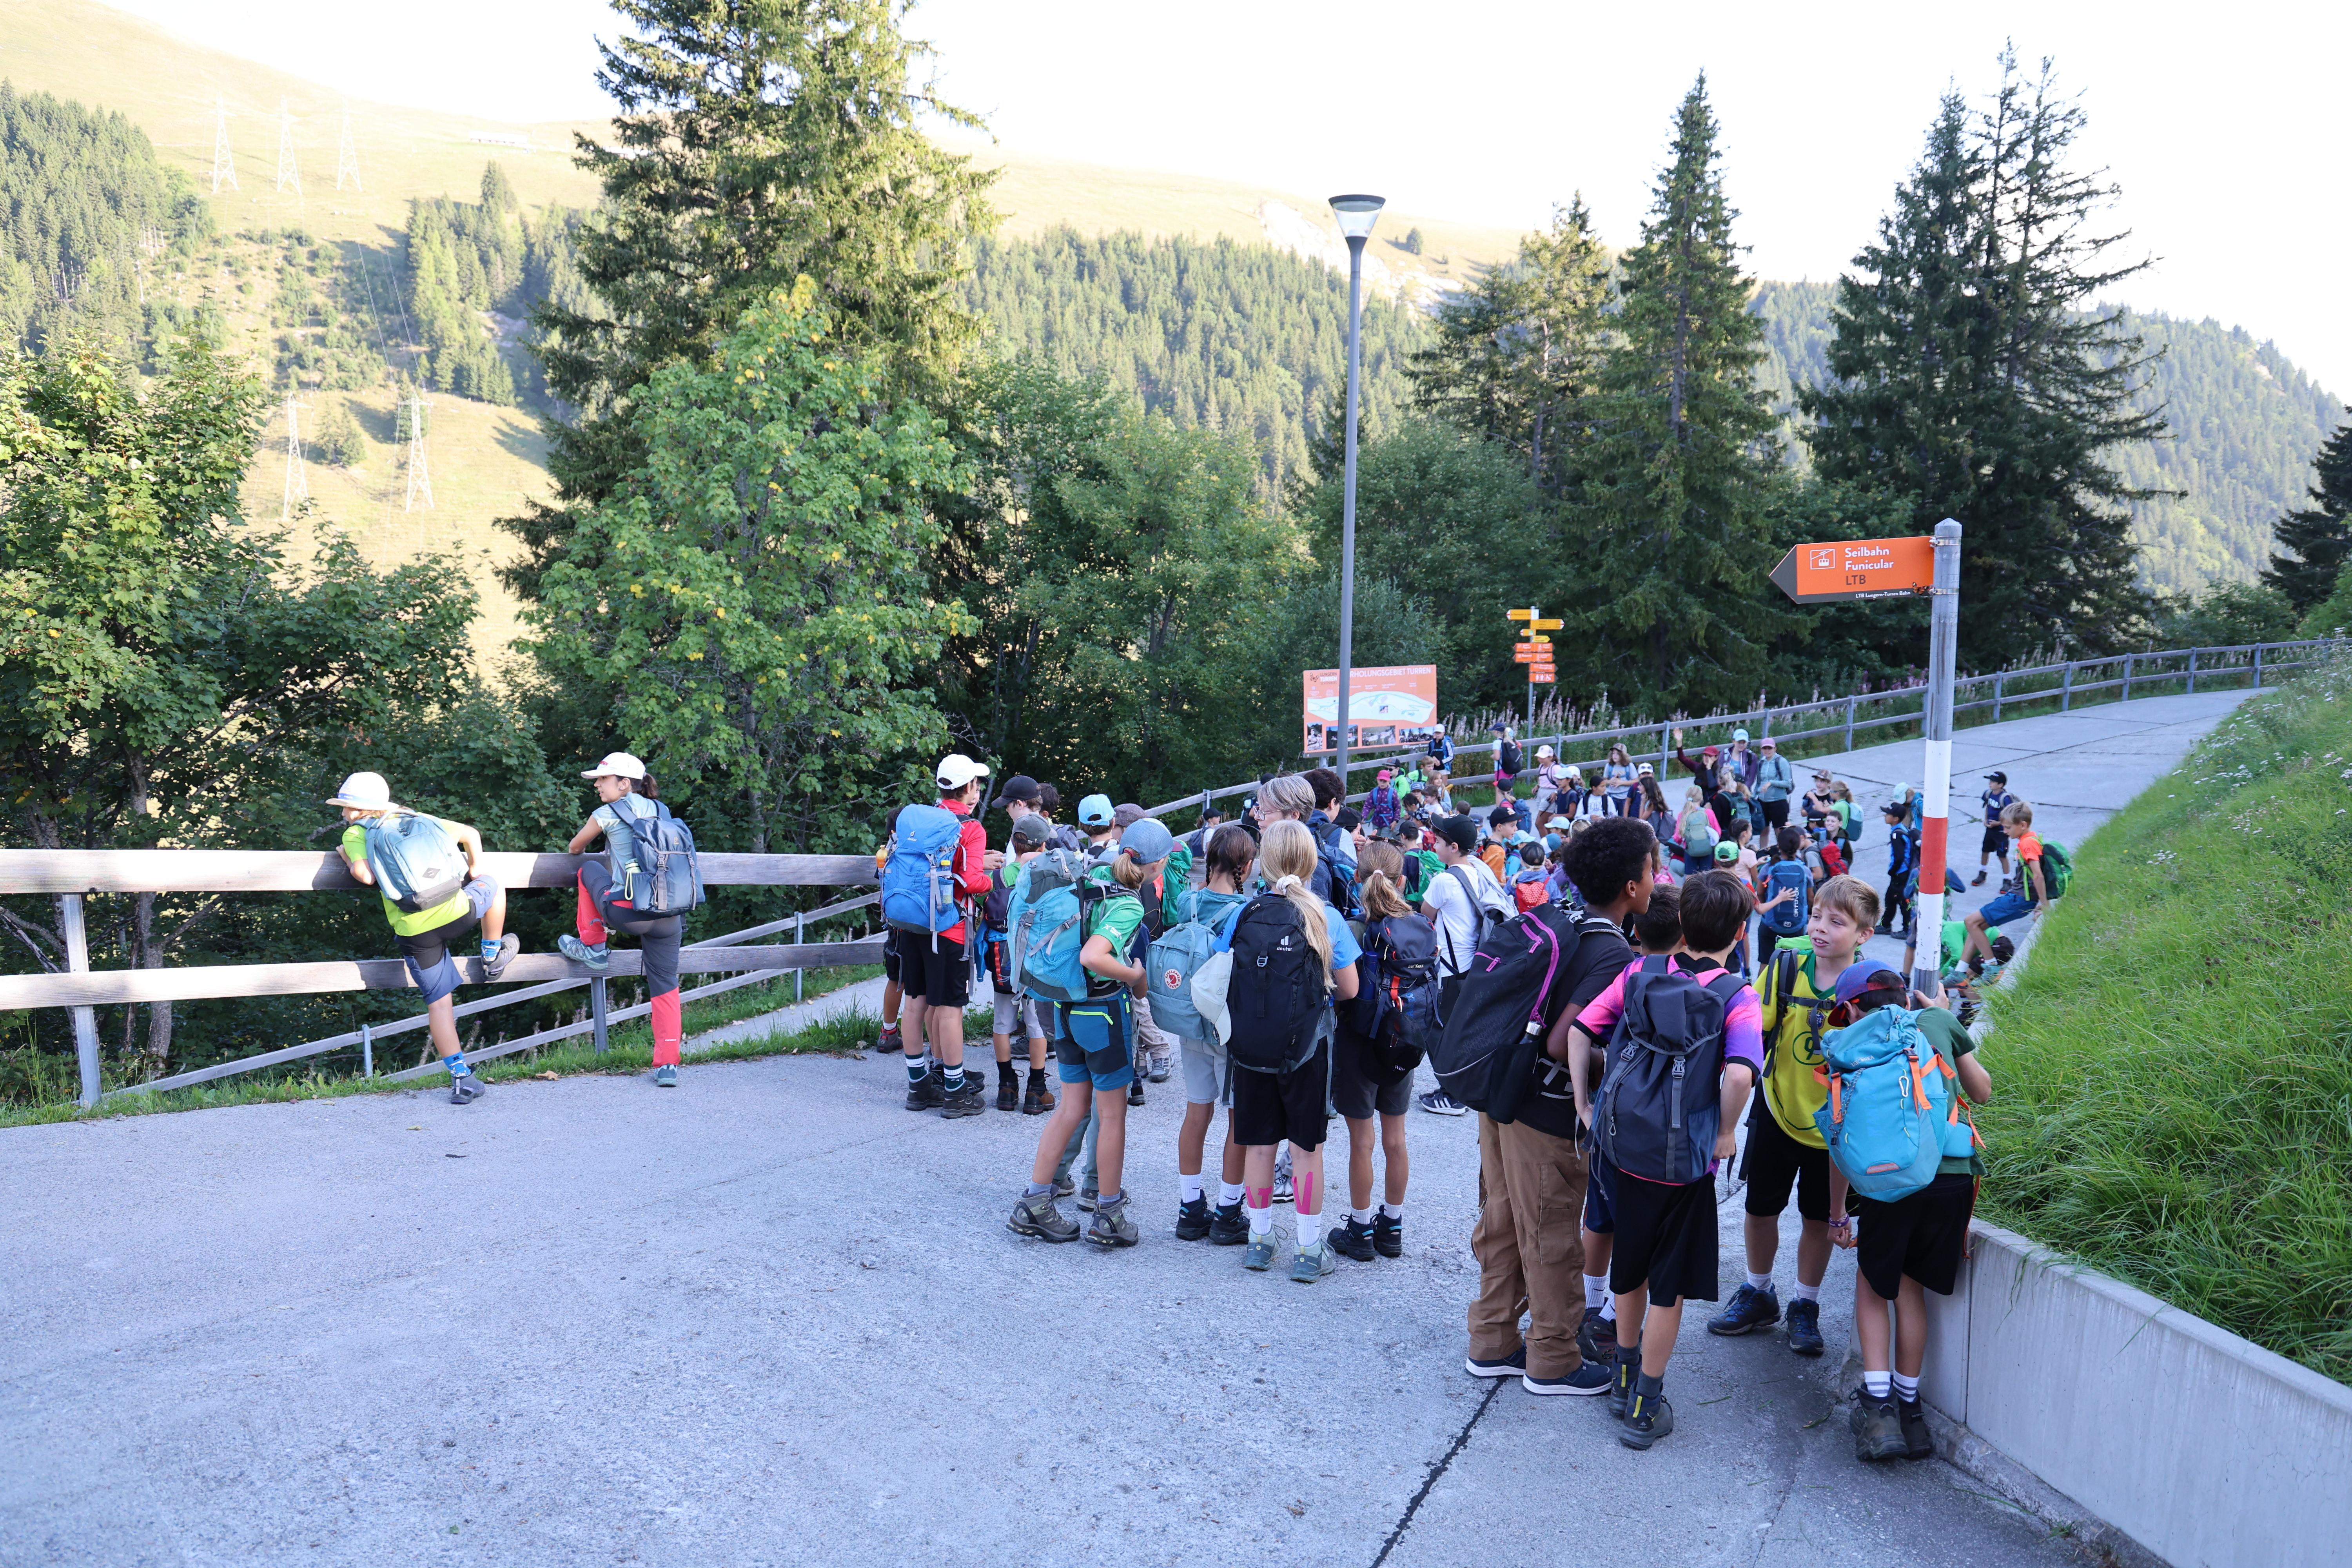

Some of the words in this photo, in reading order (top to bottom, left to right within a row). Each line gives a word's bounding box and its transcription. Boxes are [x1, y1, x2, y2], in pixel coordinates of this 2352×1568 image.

[1845, 546, 1889, 557] Seilbahn
[1845, 559, 1894, 571] Funicular
[1846, 574, 1866, 585] LTB
[1350, 668, 1406, 678] RHOLUNGSGEBIET
